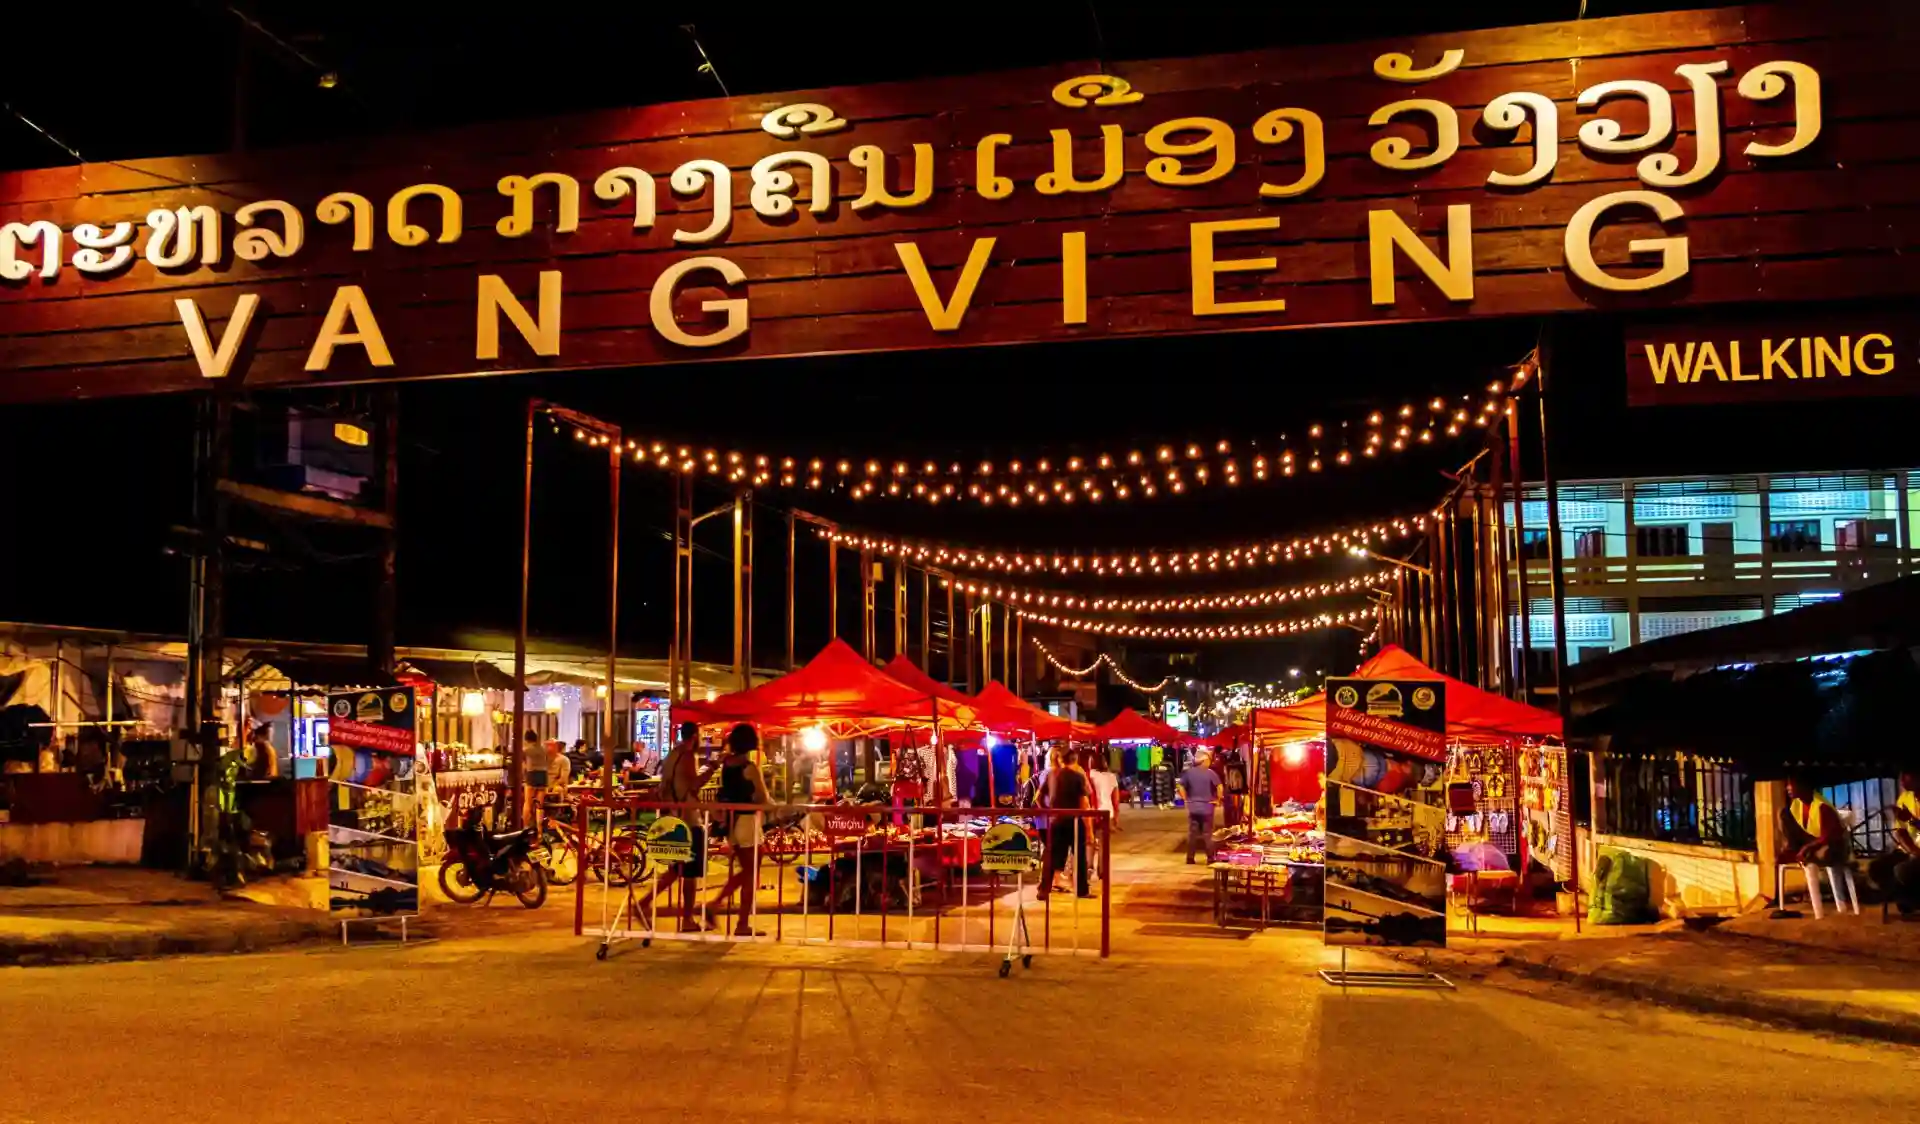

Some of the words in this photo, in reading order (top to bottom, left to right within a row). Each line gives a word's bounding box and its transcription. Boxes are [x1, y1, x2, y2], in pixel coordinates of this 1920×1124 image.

[174, 256, 750, 378] VANG
[894, 189, 1690, 331] VIENG
[1644, 333, 1895, 384] WALKING
